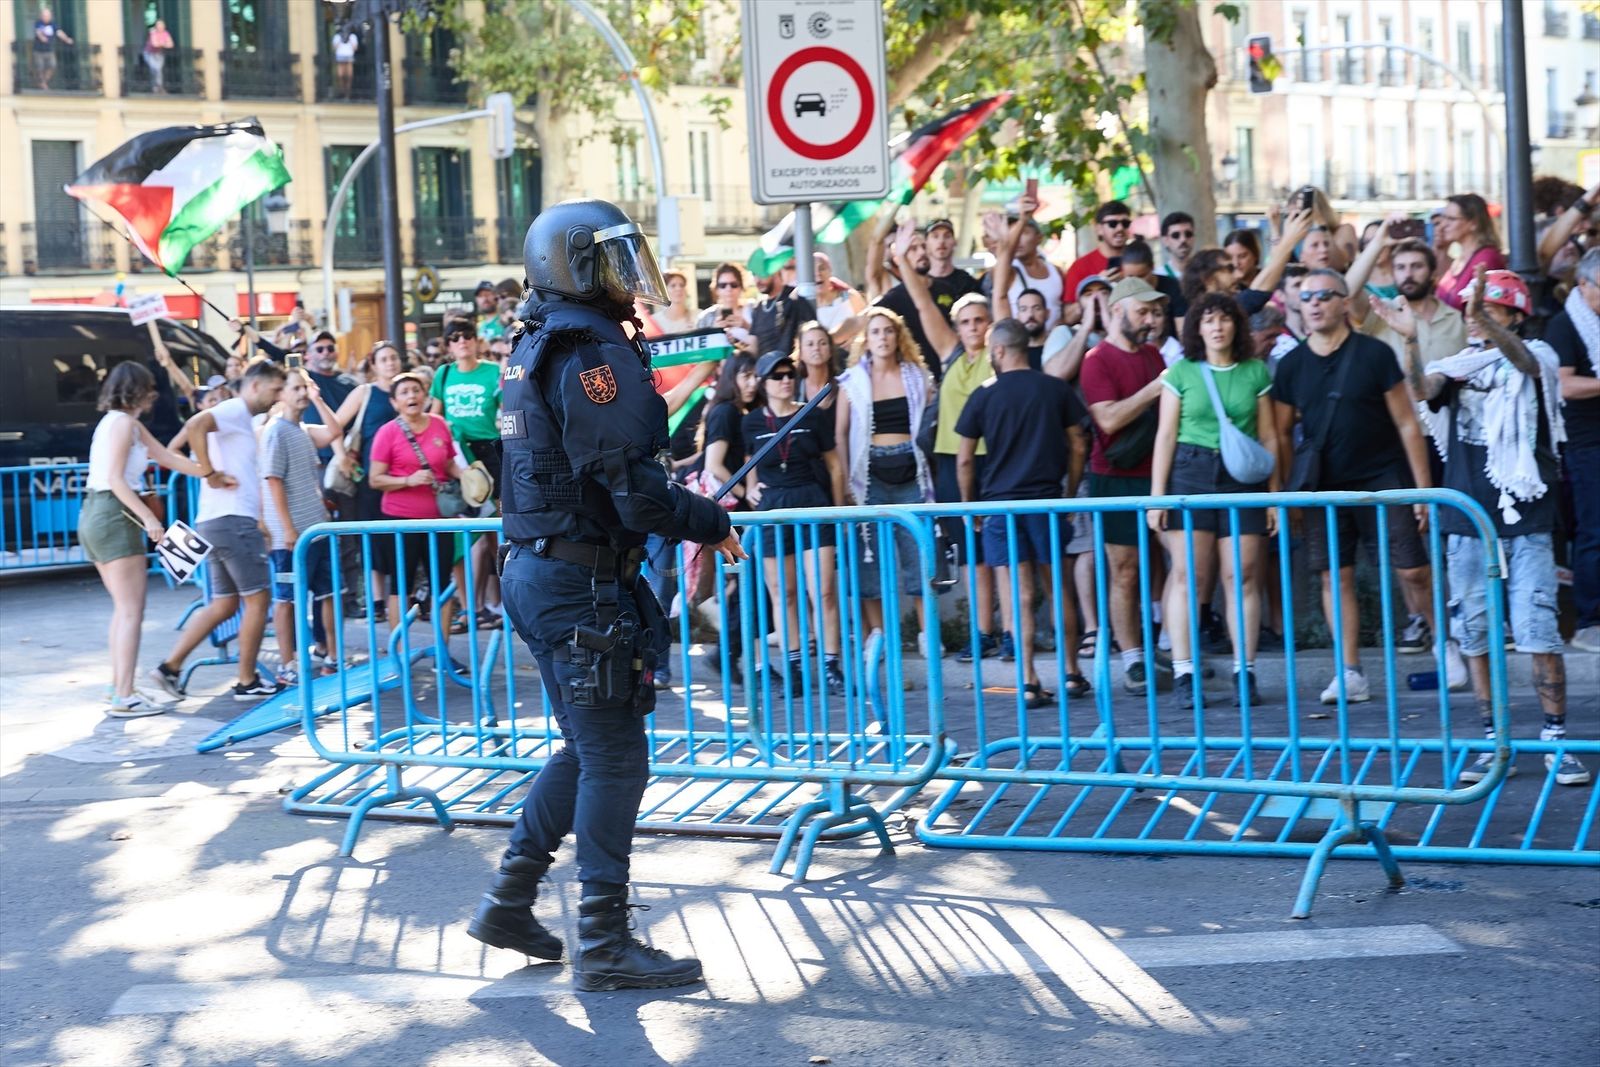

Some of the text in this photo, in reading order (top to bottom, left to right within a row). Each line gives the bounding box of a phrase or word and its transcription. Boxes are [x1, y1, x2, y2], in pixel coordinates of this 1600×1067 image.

[771, 164, 876, 177] EXCEPTO VEHÍCULOS
[789, 178, 860, 190] AUTORIZADOS
[651, 336, 708, 356] STINE
